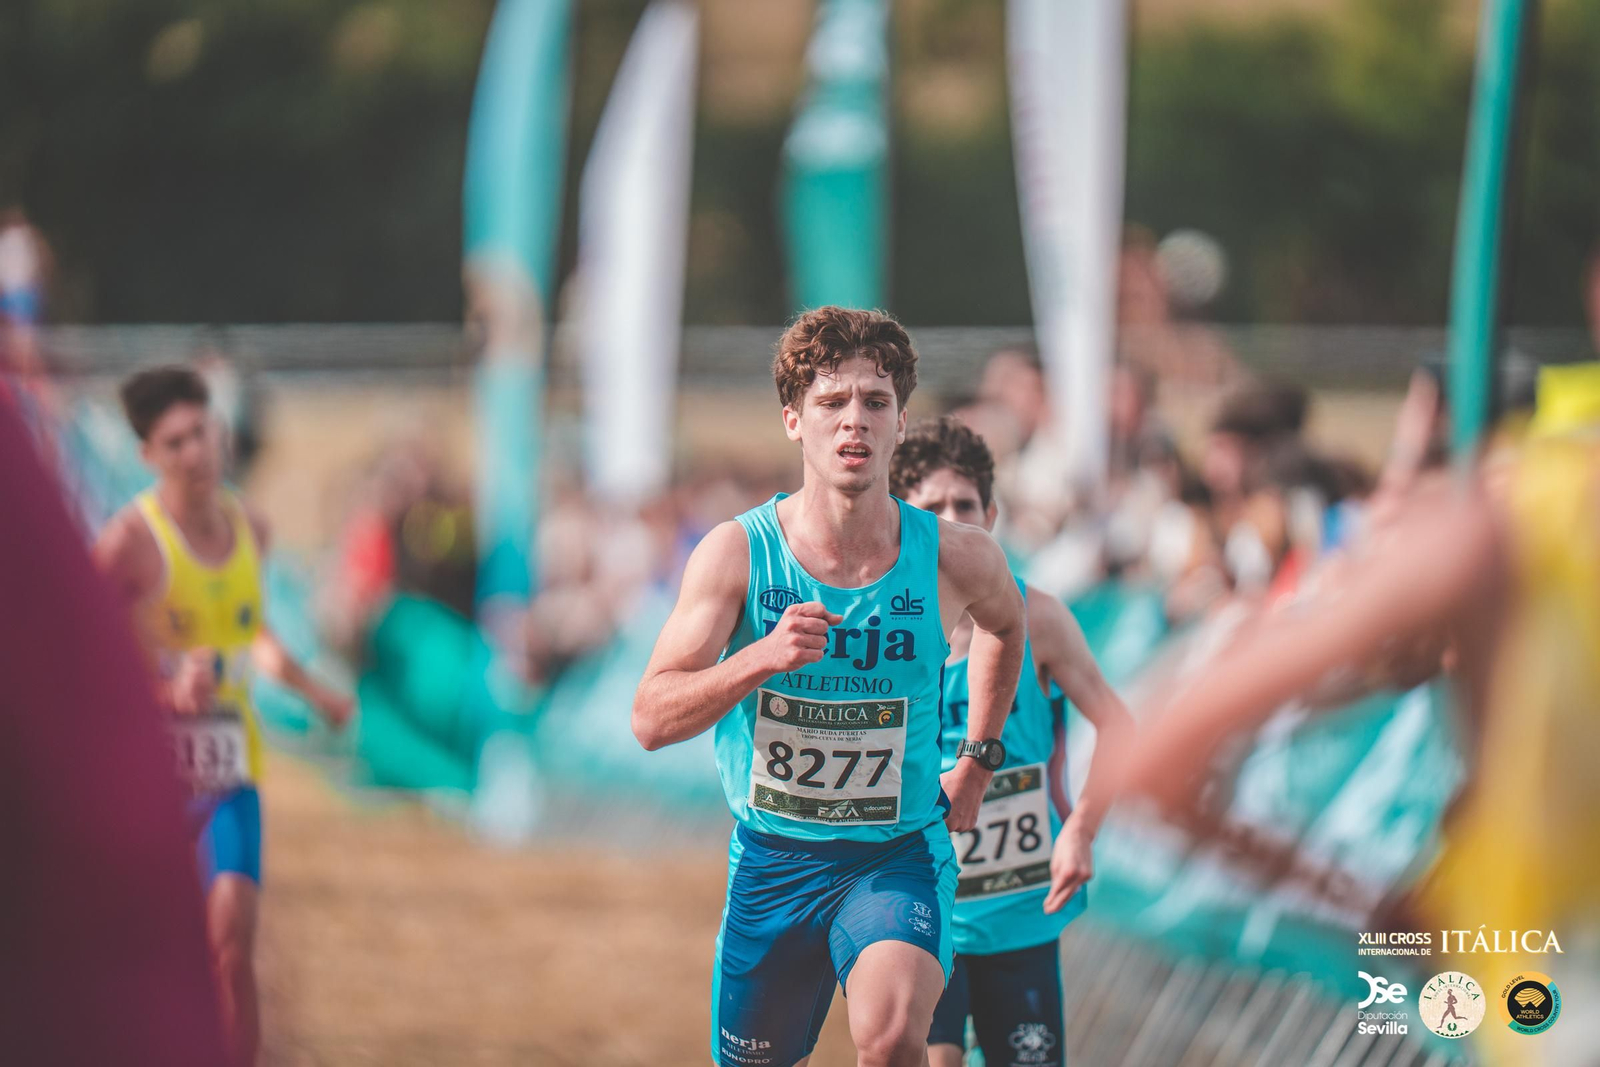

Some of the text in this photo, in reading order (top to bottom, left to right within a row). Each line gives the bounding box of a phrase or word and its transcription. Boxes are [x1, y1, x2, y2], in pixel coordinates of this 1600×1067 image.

[889, 587, 924, 615] als
[763, 615, 916, 671] rja
[780, 672, 893, 695] ATLETISMO
[798, 704, 869, 721] ITÁLICA
[766, 740, 894, 790] 8277
[721, 1026, 771, 1051] nerja
[721, 1046, 770, 1065] RUNOPRO
